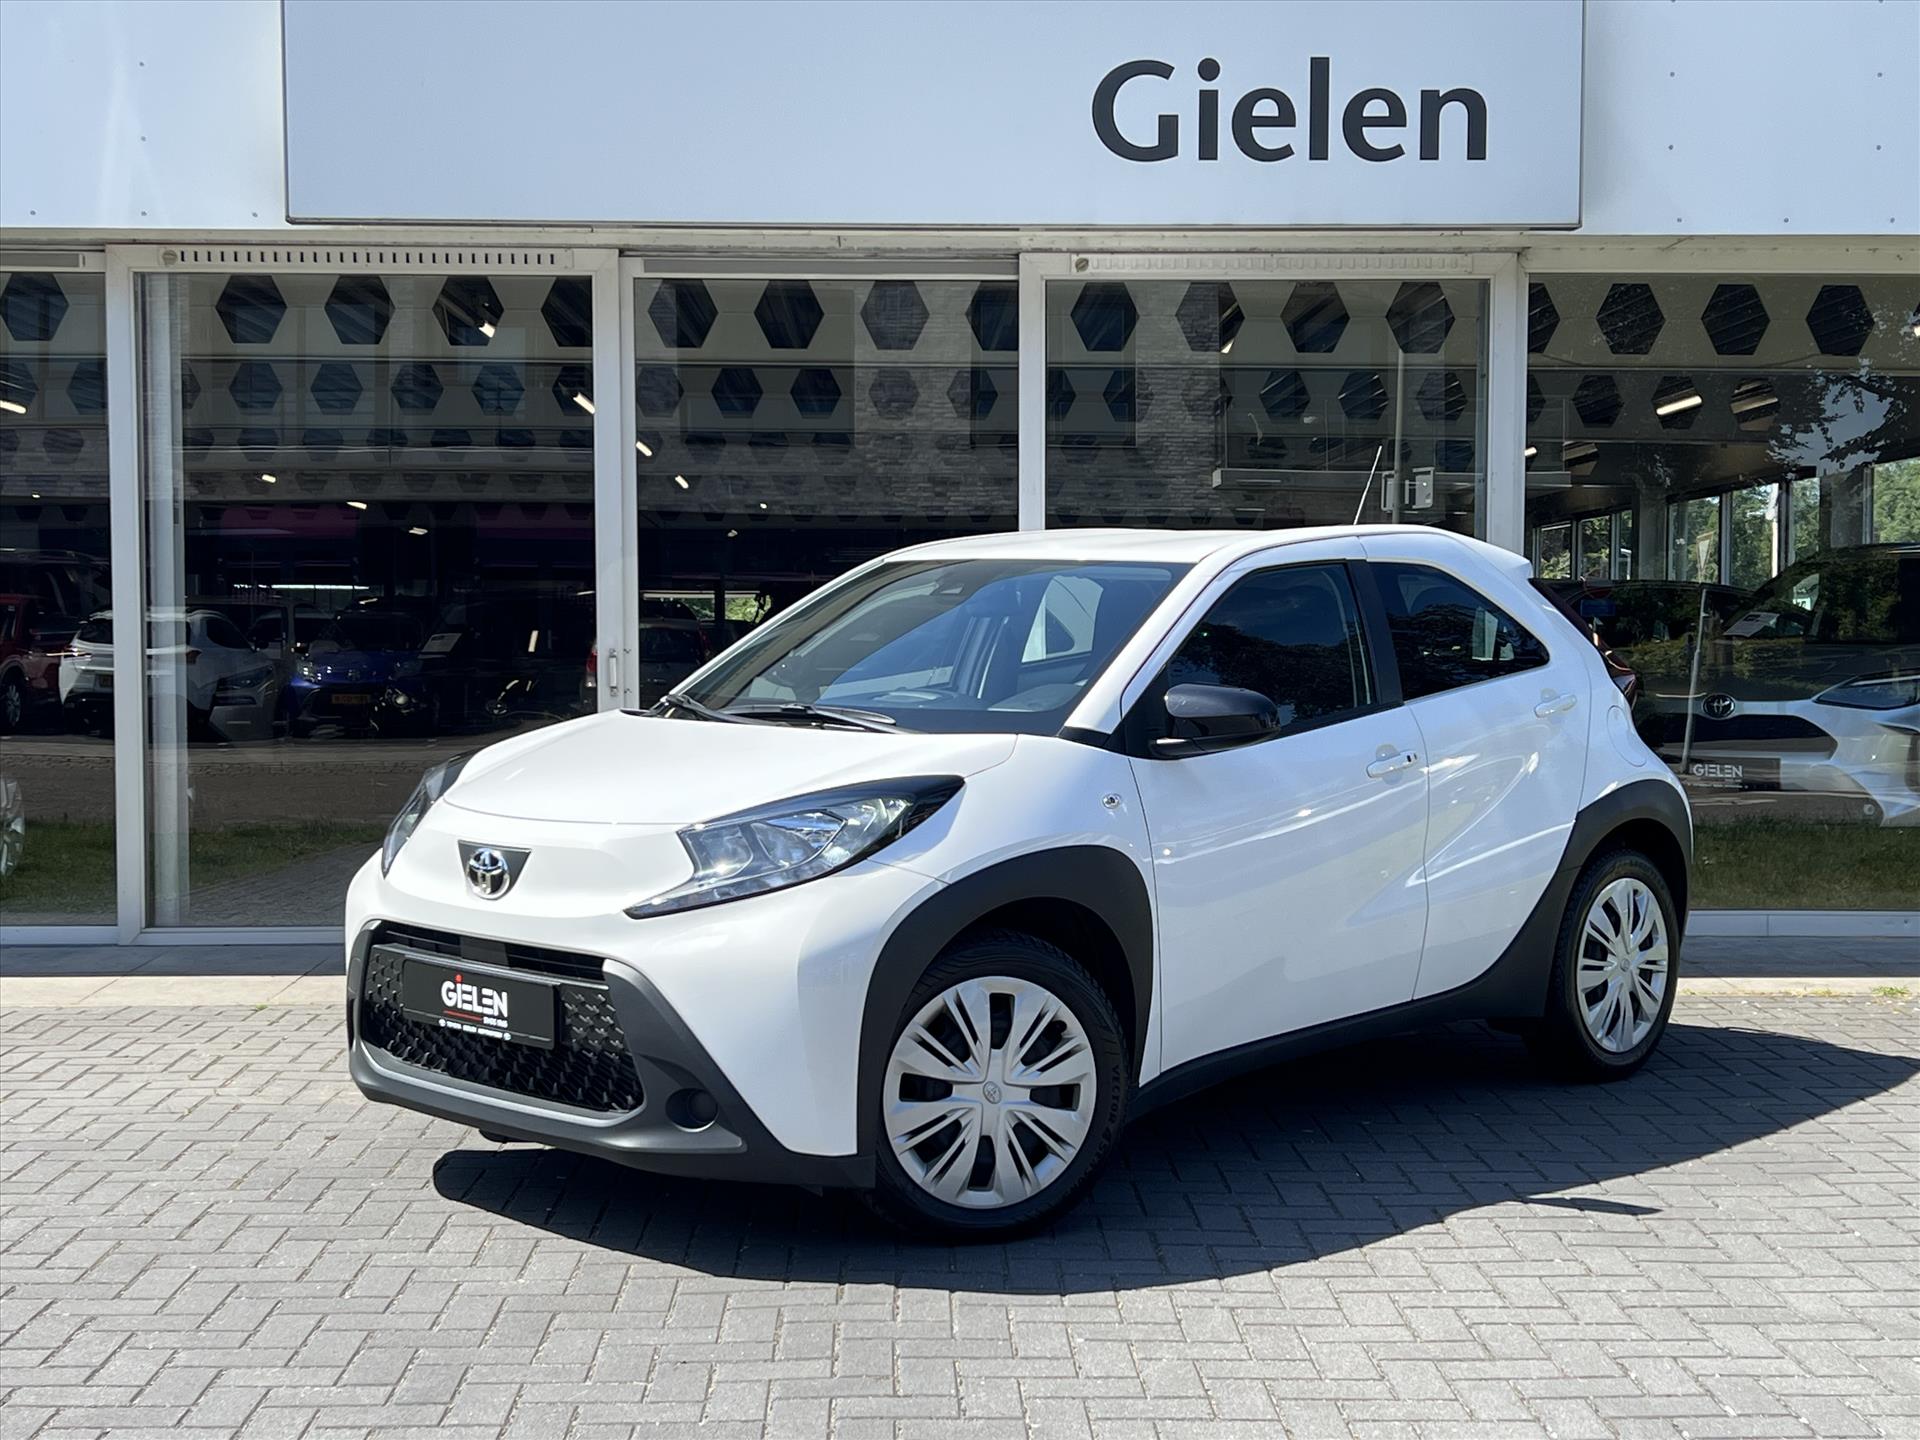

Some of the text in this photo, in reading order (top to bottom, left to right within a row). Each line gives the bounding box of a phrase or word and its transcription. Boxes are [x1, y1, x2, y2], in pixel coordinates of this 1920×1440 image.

[1091, 57, 1488, 162] Gielen
[1693, 763, 1743, 778] GIELEN
[441, 974, 508, 1018] GIELEN
[1108, 1064, 1122, 1124] VECTOR
